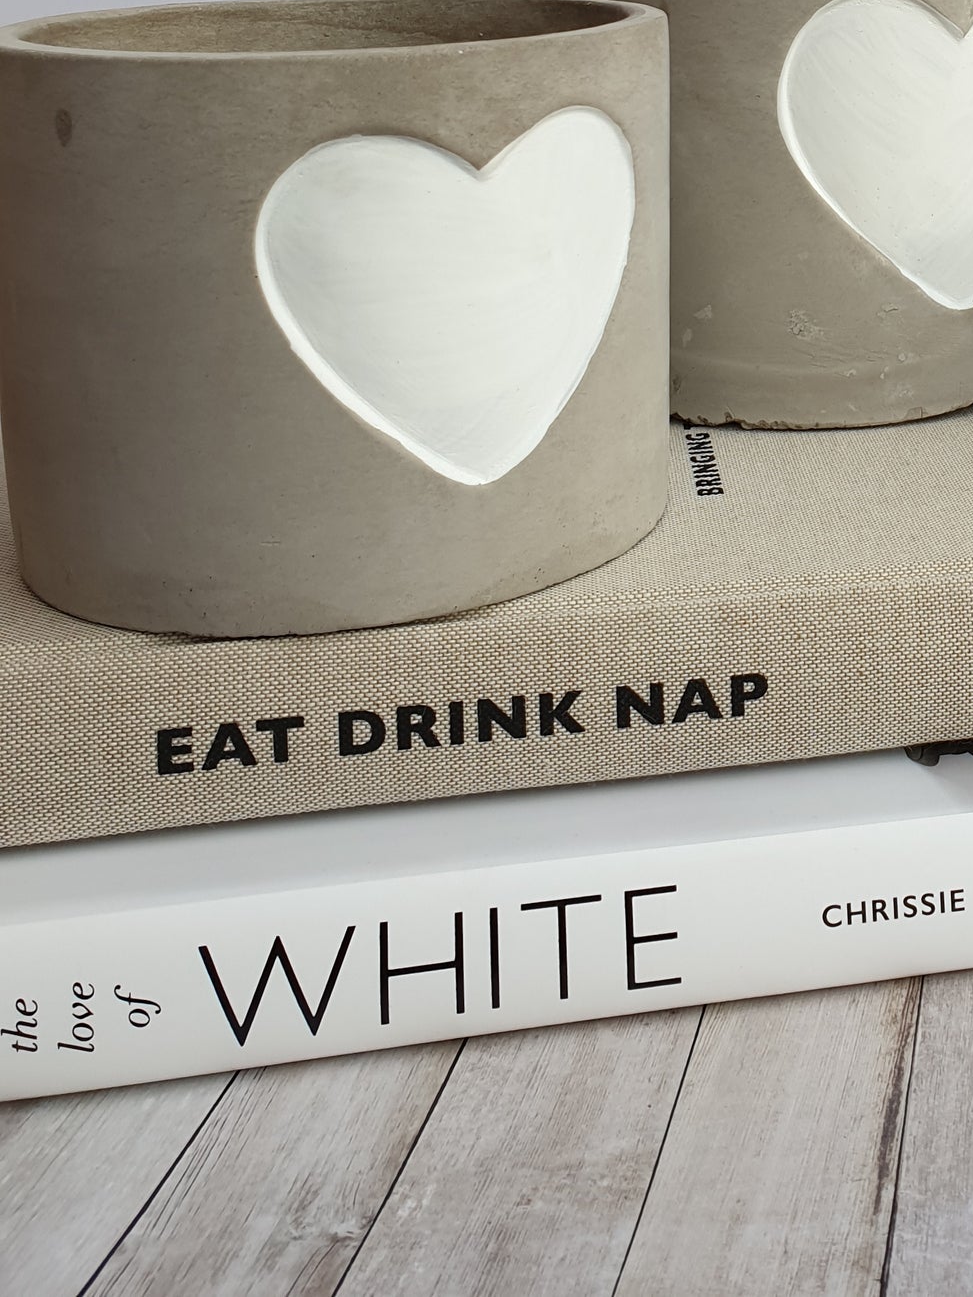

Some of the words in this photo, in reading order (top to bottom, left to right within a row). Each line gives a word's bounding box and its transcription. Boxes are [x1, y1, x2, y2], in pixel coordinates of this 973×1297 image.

[685, 432, 724, 496] BRINGING
[155, 716, 306, 776] EAT
[336, 689, 586, 756] DRINK
[614, 672, 769, 729] NAP
[821, 889, 966, 929] CHRISSIE
[198, 884, 682, 1046] WHITE
[0, 998, 39, 1053] the
[57, 981, 95, 1053] love
[113, 984, 162, 1028] of
